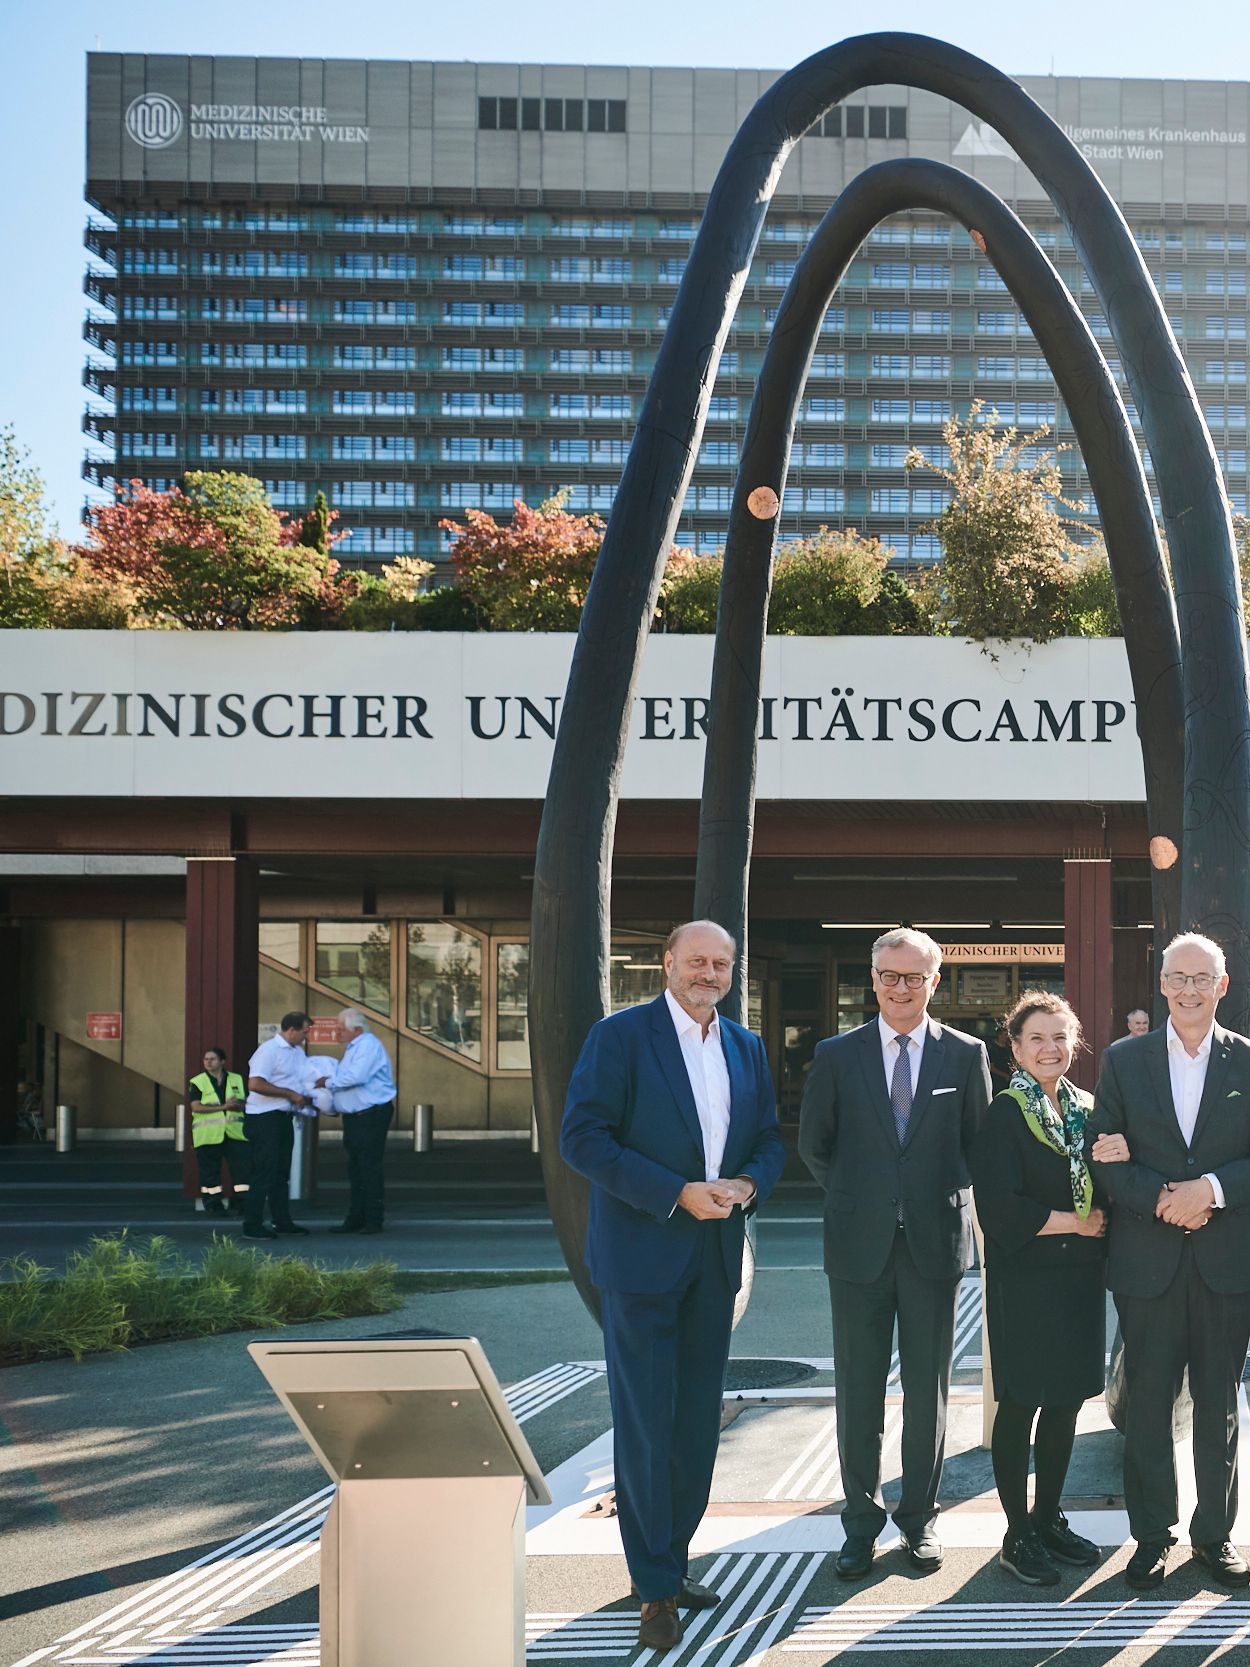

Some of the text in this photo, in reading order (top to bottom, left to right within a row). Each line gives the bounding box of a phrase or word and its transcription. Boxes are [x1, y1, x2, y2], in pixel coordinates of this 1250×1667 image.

[190, 104, 328, 123] MEDIZINISCHE
[190, 121, 370, 143] UNIVERSITÄT WIEN
[1063, 125, 1246, 144] llgemeines Krankenhaus
[1082, 144, 1164, 160] Stadt Wien
[465, 687, 1140, 743] UNERITÄTSCAMP
